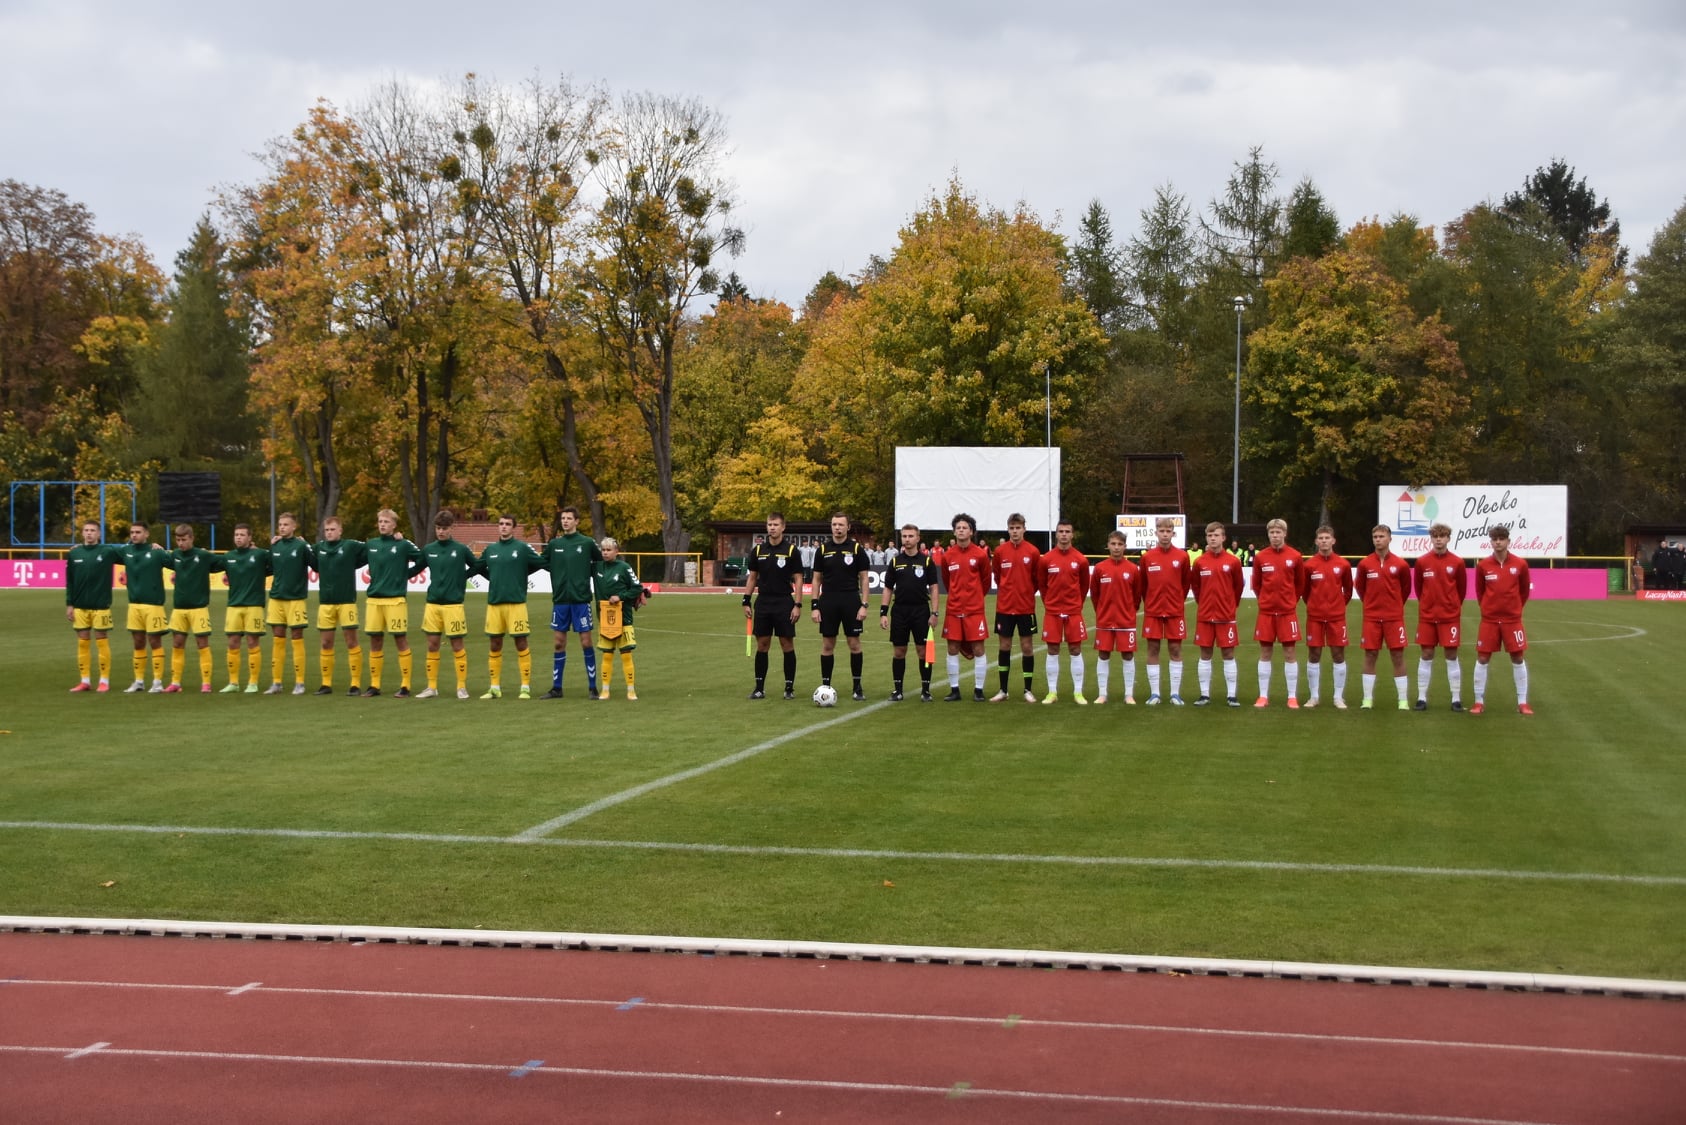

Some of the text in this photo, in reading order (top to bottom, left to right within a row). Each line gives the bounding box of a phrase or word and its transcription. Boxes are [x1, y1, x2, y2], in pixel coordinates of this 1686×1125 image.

[1462, 490, 1518, 519] Olecko
[1119, 517, 1147, 527] POLSKA
[13, 562, 33, 586] T
[348, 611, 355, 622] 6
[1030, 614, 1035, 626] 1
[391, 619, 402, 630] 24
[451, 621, 461, 633] 20
[514, 620, 524, 632] 25
[978, 620, 985, 632] 4
[1179, 620, 1185, 632] 3
[1290, 621, 1298, 633] 11
[1129, 632, 1135, 644] 8
[1228, 627, 1234, 639] 6
[1399, 627, 1405, 639] 2
[1450, 627, 1457, 639] 9
[1513, 630, 1524, 643] 10
